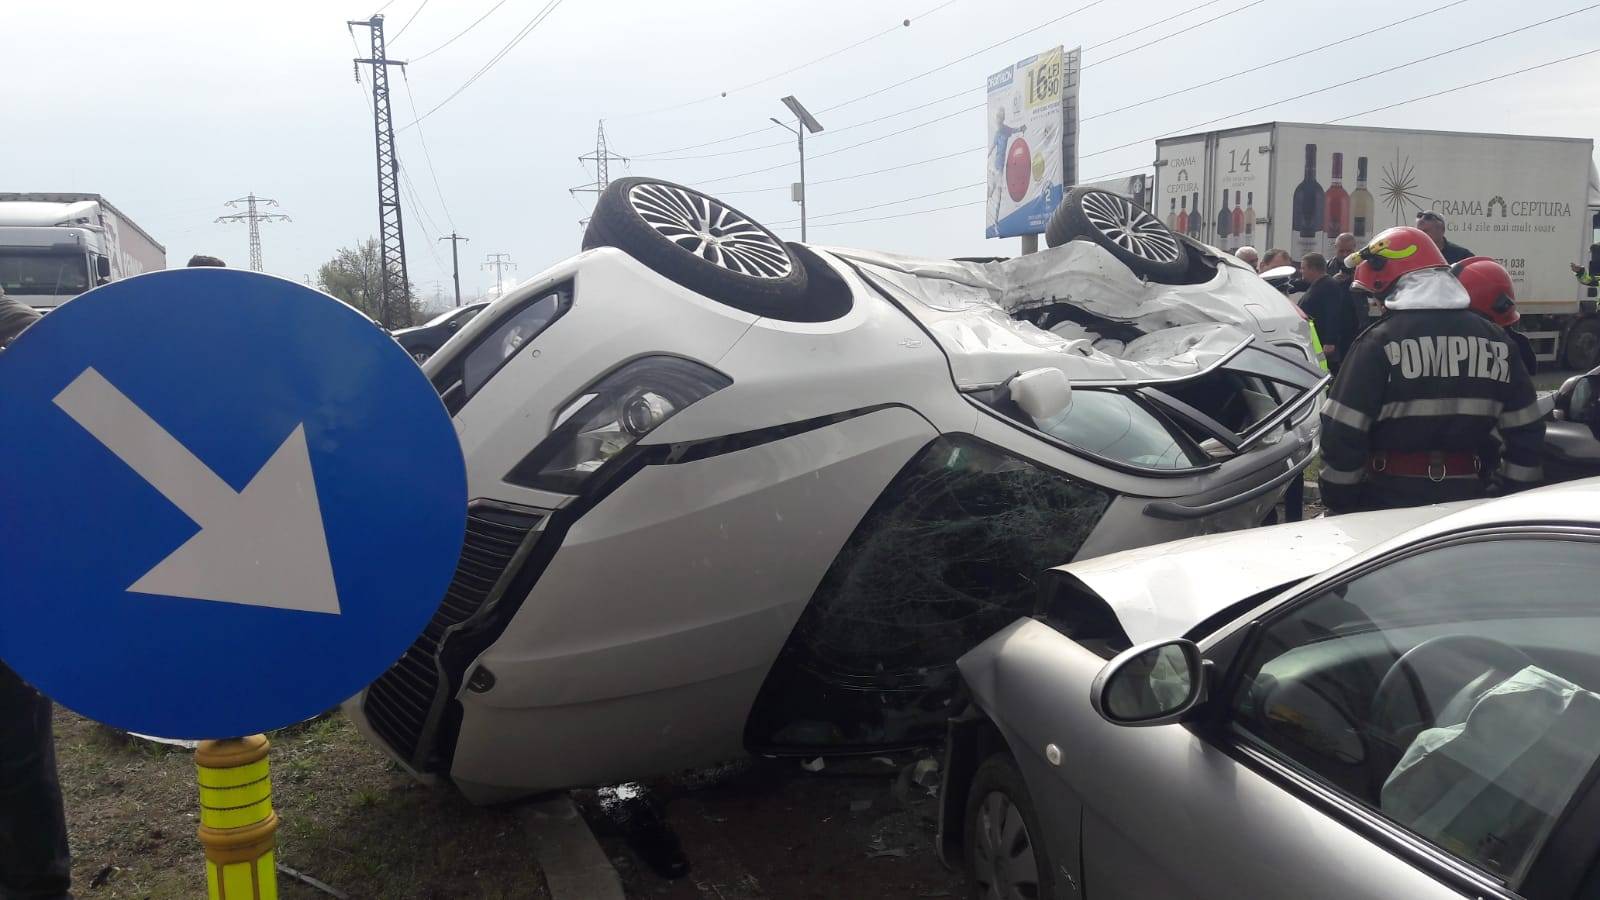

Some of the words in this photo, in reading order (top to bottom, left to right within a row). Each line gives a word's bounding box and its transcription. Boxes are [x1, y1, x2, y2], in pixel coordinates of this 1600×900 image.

[1228, 149, 1251, 173] 14
[1167, 183, 1199, 193] CEPTURA
[1432, 200, 1483, 216] CRAMA
[1511, 201, 1571, 217] CEPTURA
[1447, 222, 1459, 232] Cu
[1462, 222, 1472, 232] 14
[1475, 222, 1490, 232] zile
[1510, 258, 1525, 269] 038
